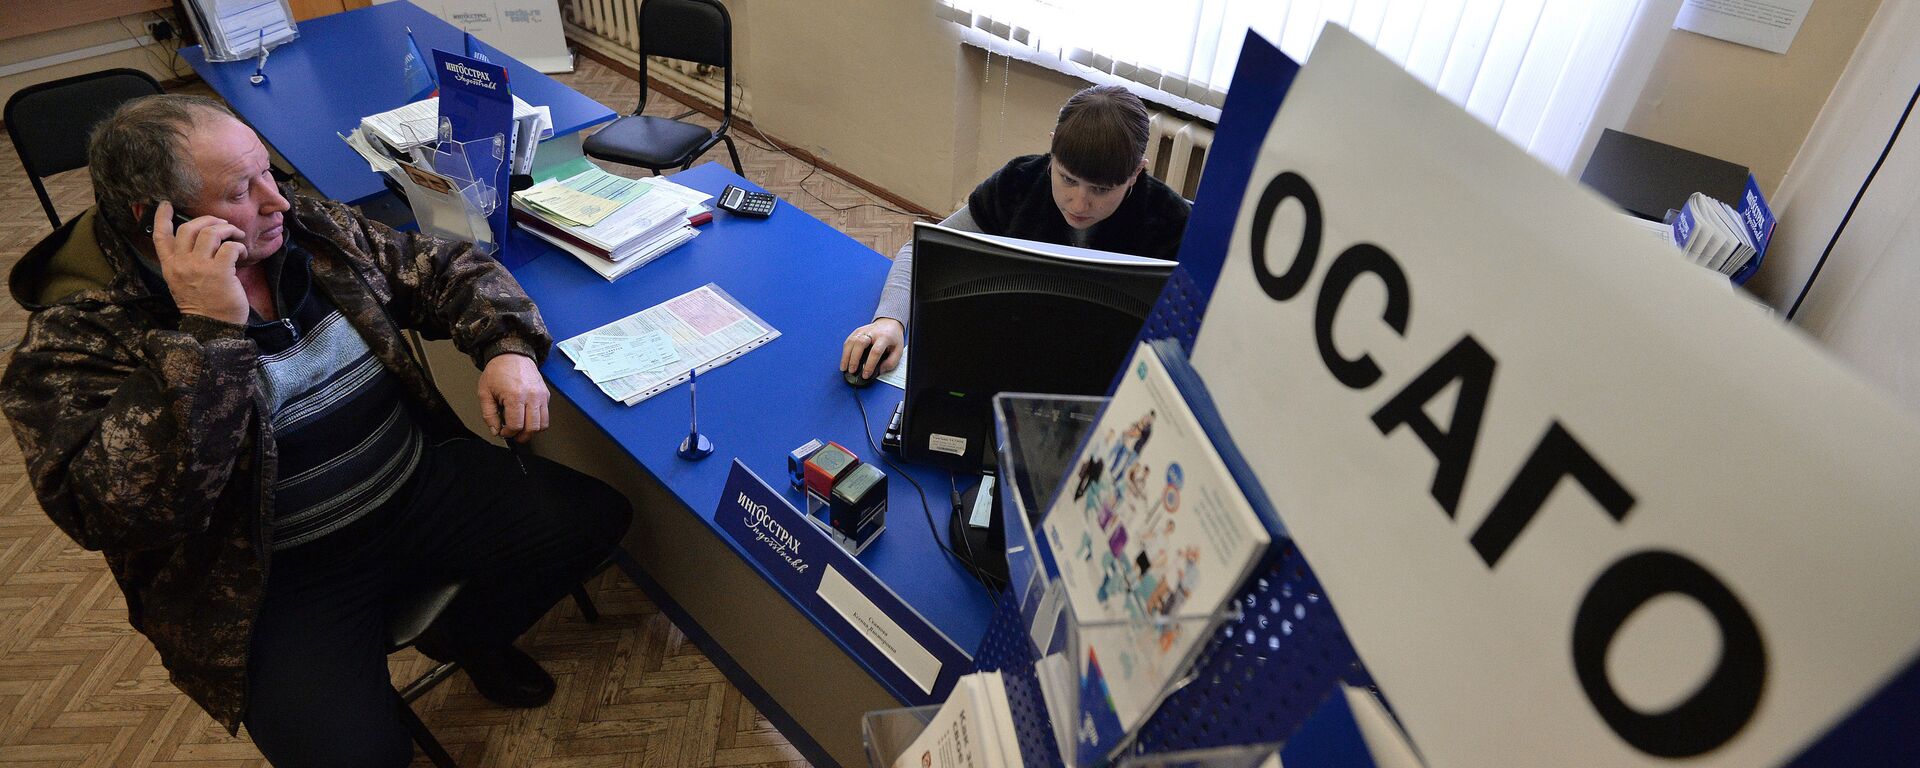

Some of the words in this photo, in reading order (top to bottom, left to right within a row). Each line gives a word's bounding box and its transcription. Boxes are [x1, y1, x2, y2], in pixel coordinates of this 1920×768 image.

[445, 62, 491, 82] ИНГОССТРАХ
[1251, 171, 1767, 759] ОСАГО
[737, 491, 801, 555] ИНГОССТРАХ
[743, 513, 809, 574] Ingosstrakh
[960, 709, 969, 748] Как
